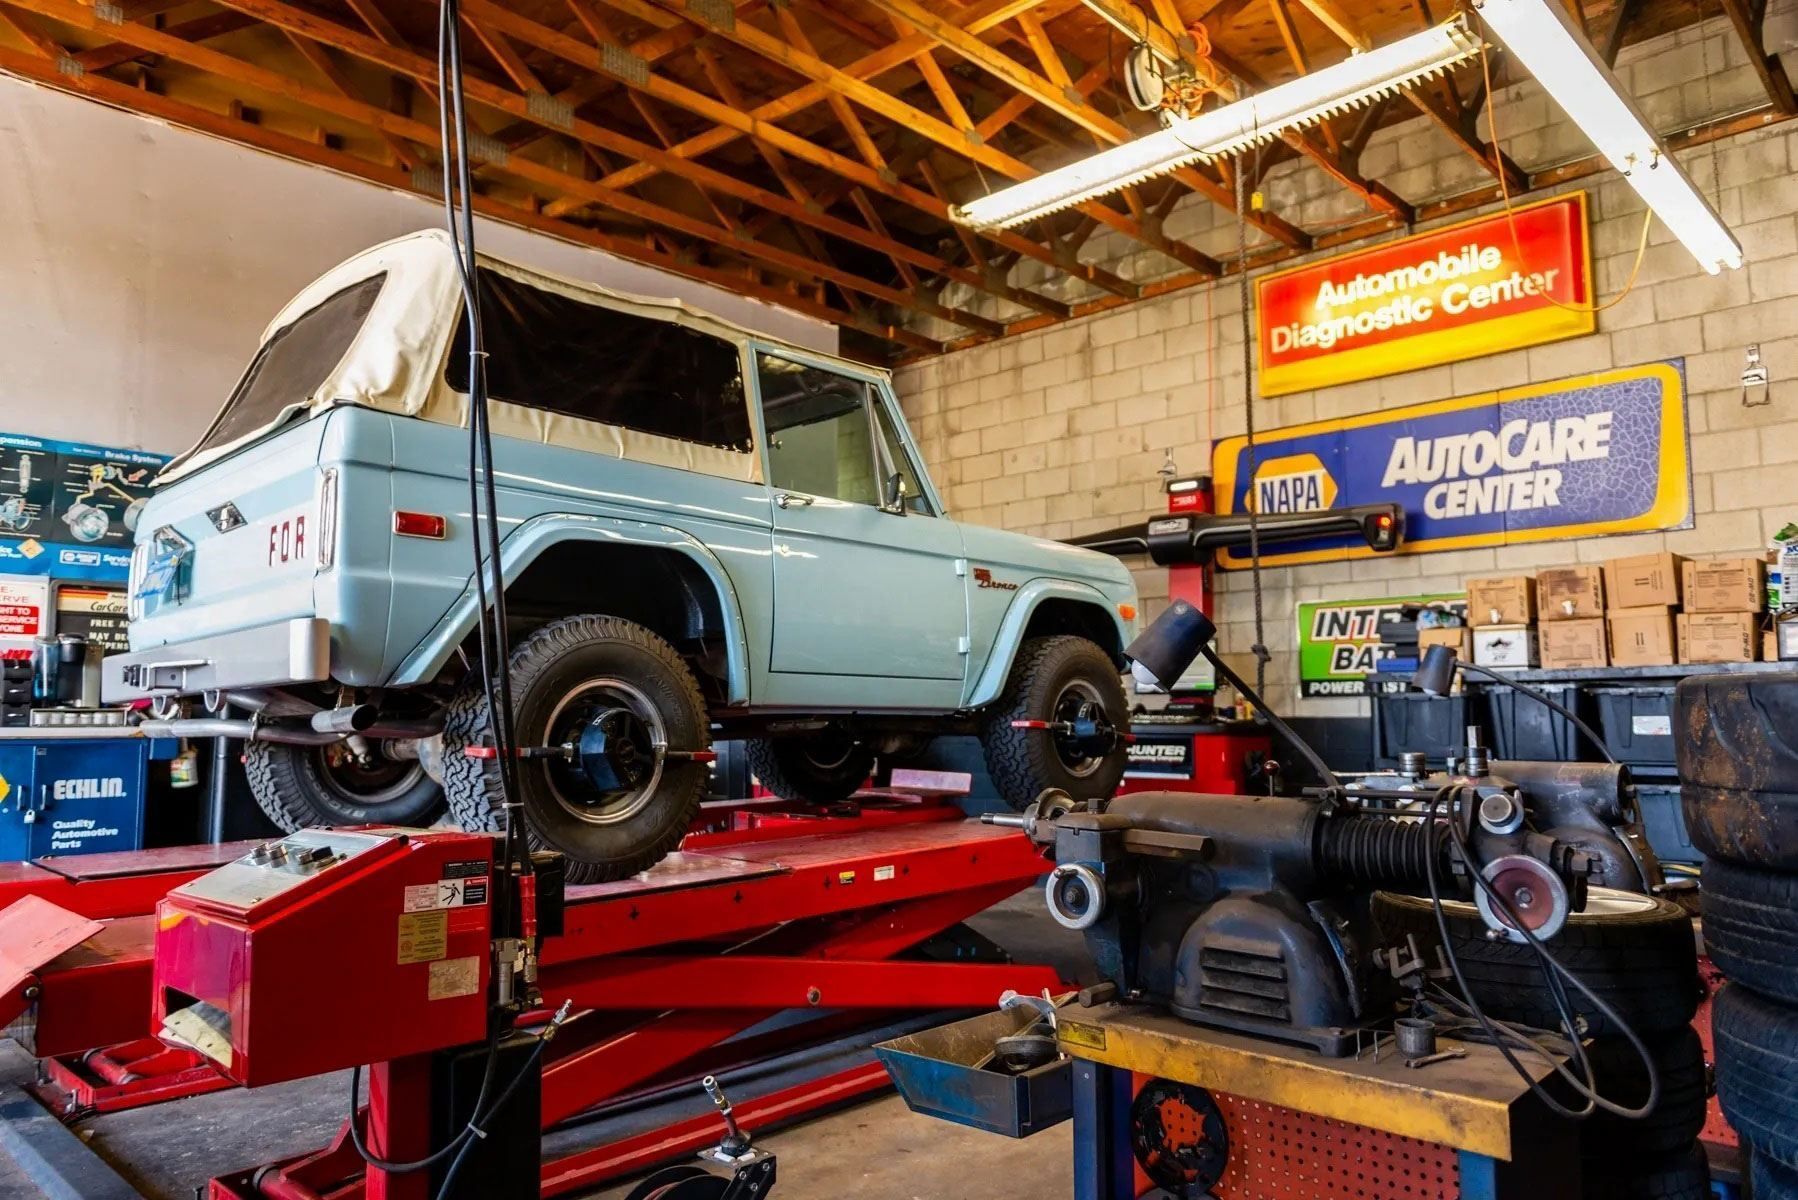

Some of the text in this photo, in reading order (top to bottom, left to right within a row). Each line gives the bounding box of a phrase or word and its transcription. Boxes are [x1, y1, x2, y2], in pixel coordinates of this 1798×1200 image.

[1314, 244, 1501, 310] Automobile
[1270, 268, 1559, 354] Diagnostic Center
[1381, 411, 1614, 488] AUTOCARE
[105, 450, 131, 461] Brake
[132, 453, 163, 464] System
[1261, 475, 1320, 514] NAPA
[1423, 468, 1563, 520] CENTER
[977, 579, 1019, 590] Bronco
[17, 607, 31, 616] TO
[90, 619, 114, 628] FREE
[88, 632, 110, 641] MAY
[1309, 681, 1365, 694] POWER
[1126, 744, 1186, 756] HUNTER
[52, 819, 96, 830] Quality
[51, 827, 119, 840] Automotive
[51, 840, 82, 850] Parts
